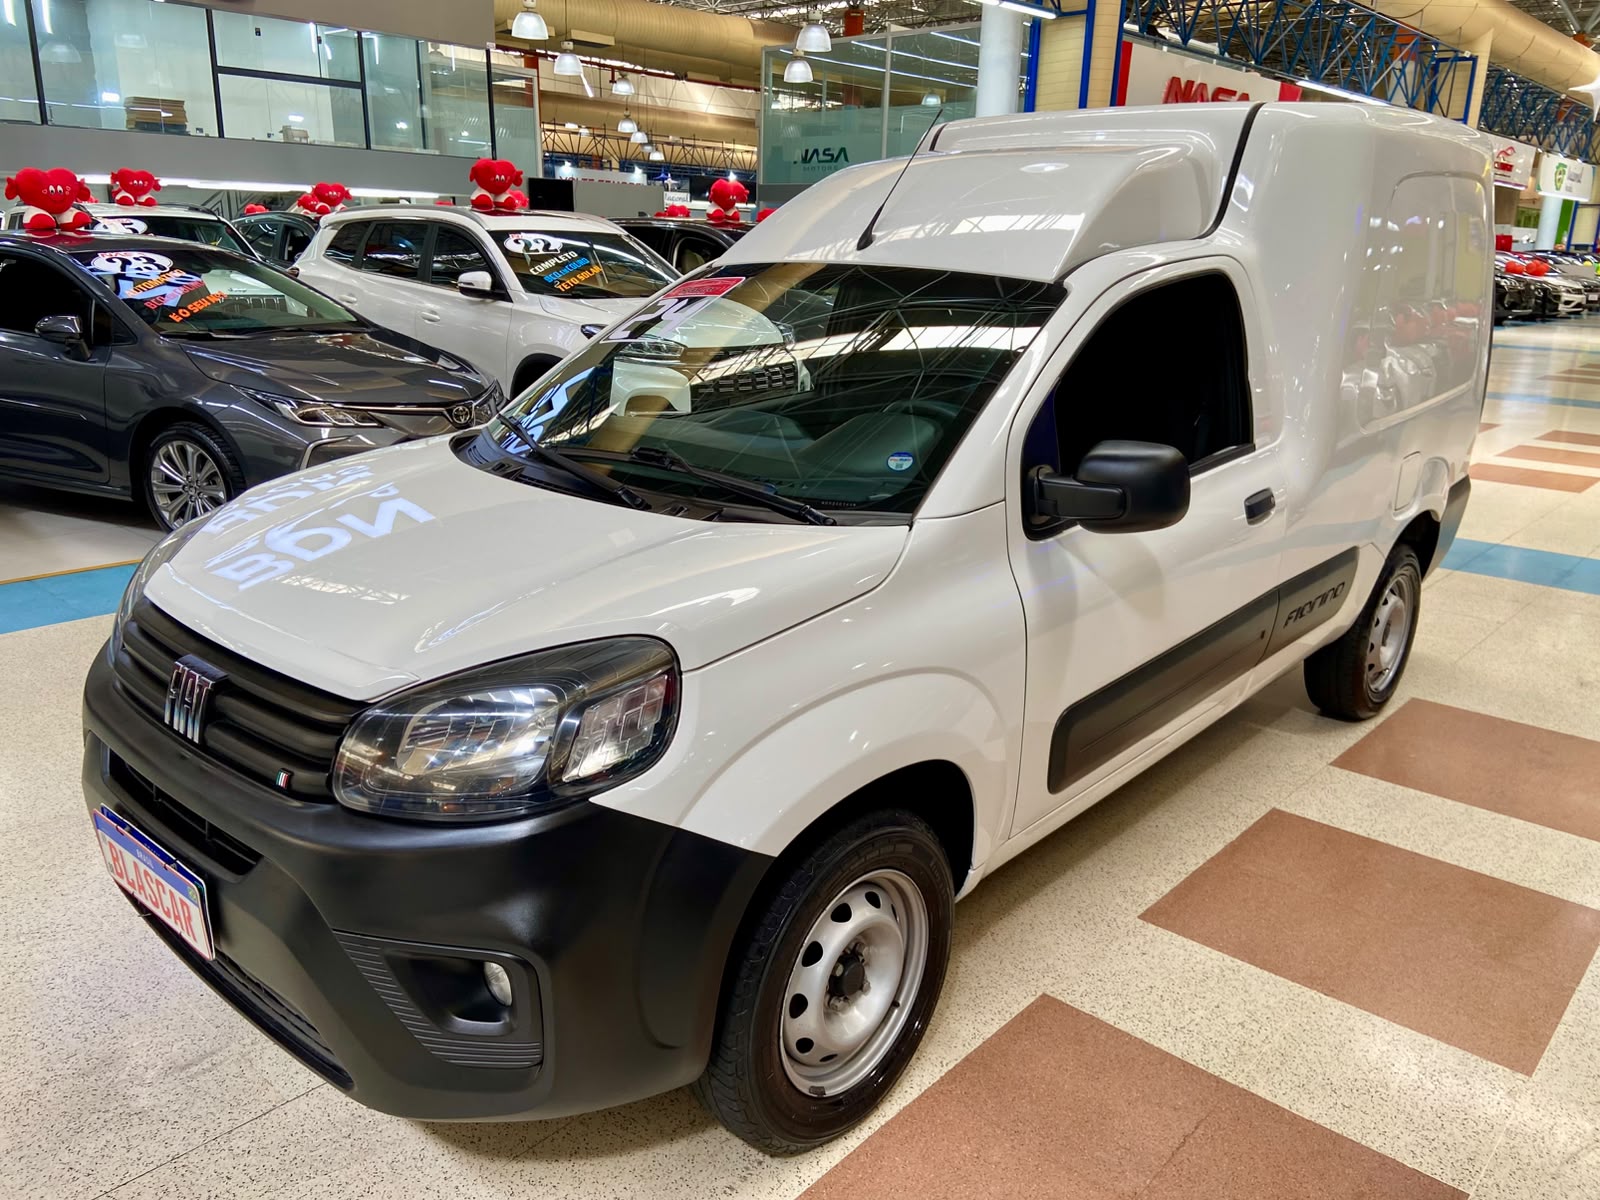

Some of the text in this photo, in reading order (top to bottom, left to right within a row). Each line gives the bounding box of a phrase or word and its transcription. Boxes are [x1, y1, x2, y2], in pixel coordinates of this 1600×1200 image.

[793, 147, 849, 164] NASA
[513, 238, 559, 253] 22
[105, 255, 168, 273] 23
[529, 250, 578, 275] COMPLETO
[108, 841, 198, 943] BLASCAR
